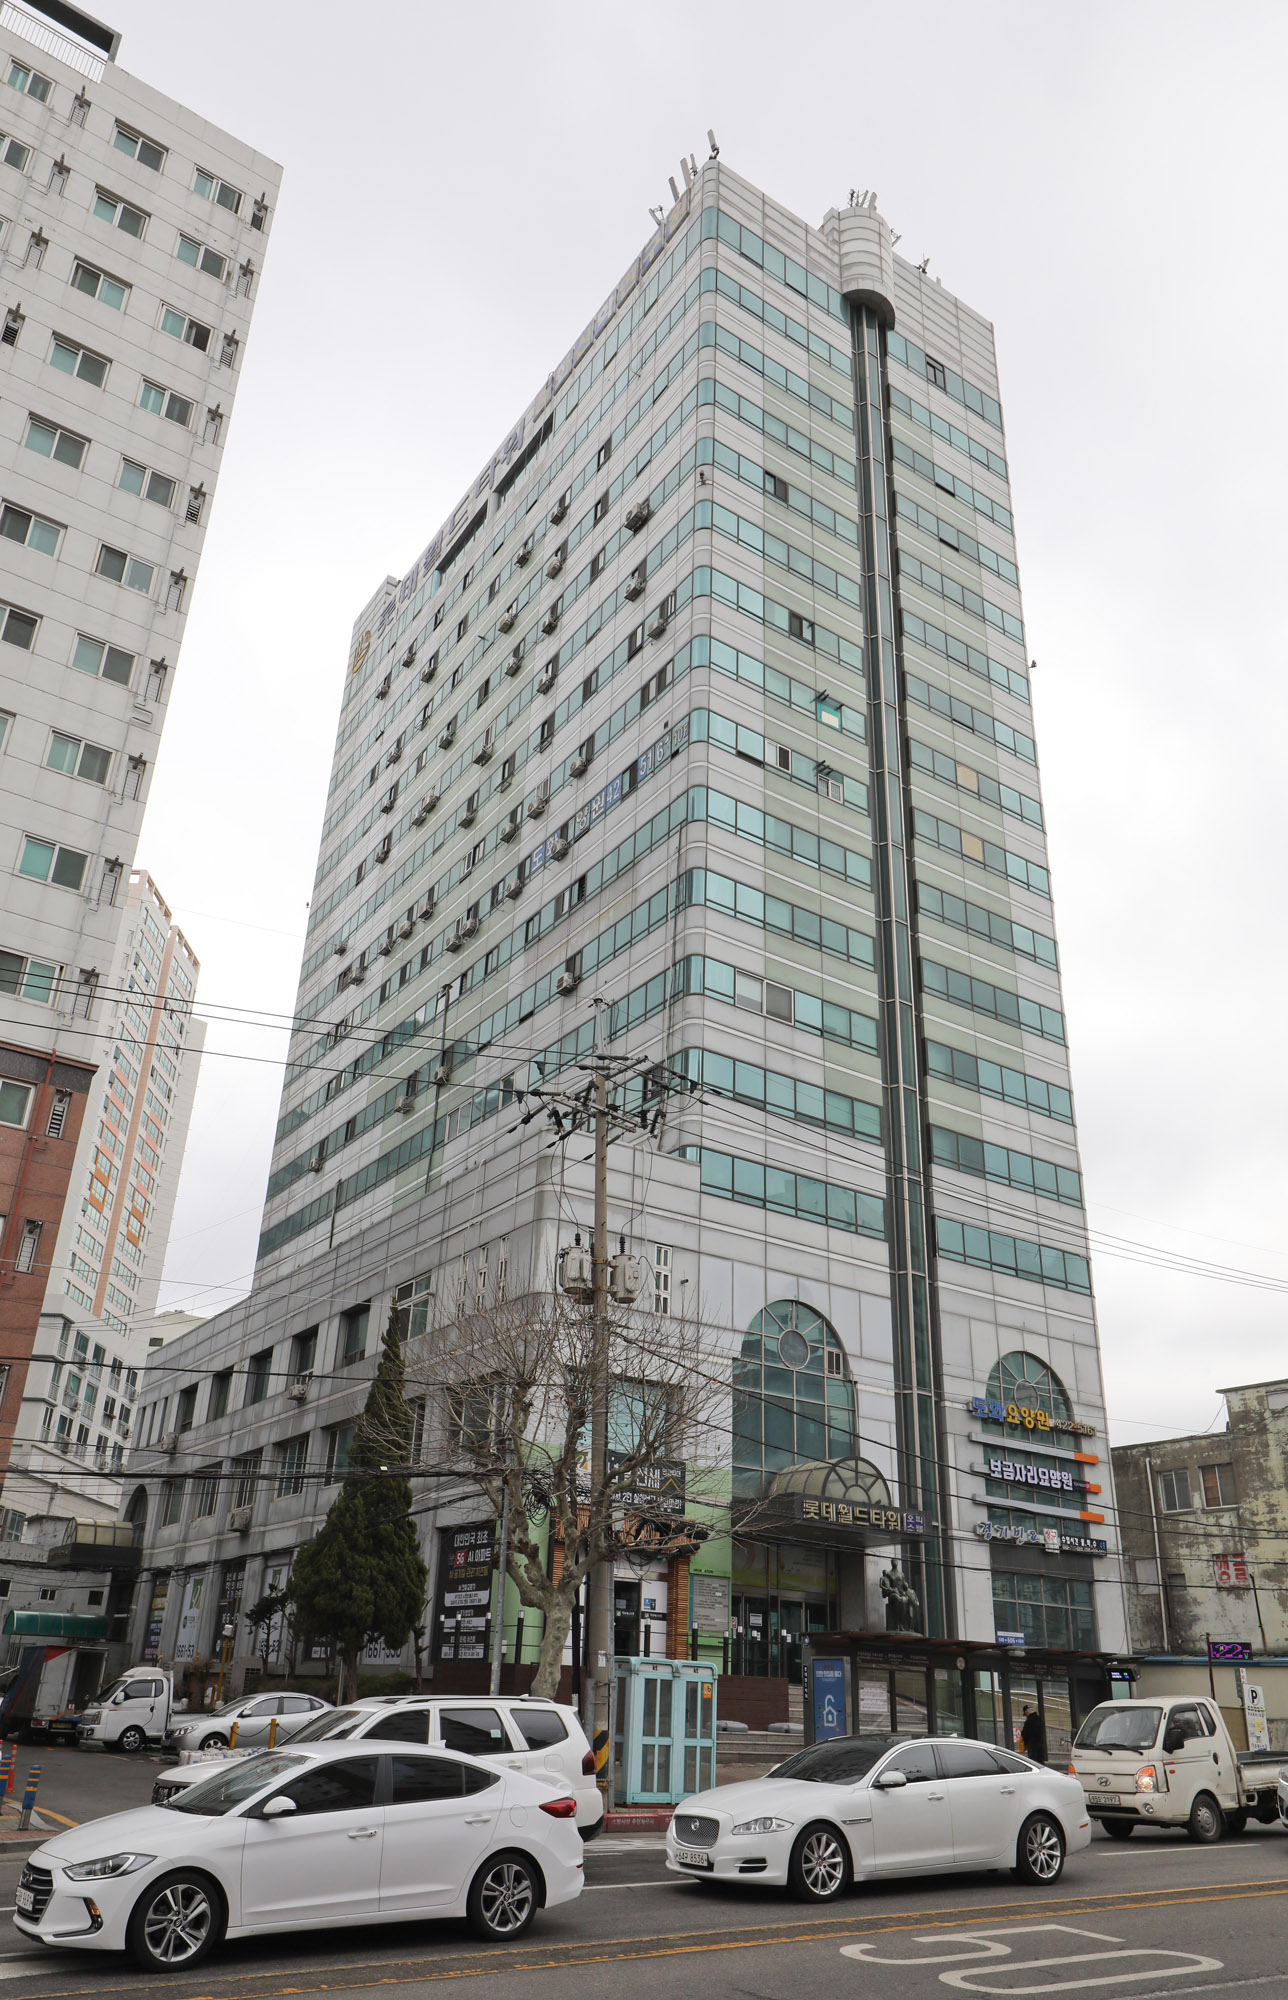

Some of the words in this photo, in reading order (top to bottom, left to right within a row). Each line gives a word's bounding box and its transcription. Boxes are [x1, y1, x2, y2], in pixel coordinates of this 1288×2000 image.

[378, 417, 525, 639] 롯데월드타워
[972, 1397, 1050, 1431] 도화요양원
[990, 1458, 1073, 1491] 보금자리요양원
[803, 1500, 901, 1531] 롯데월드타워
